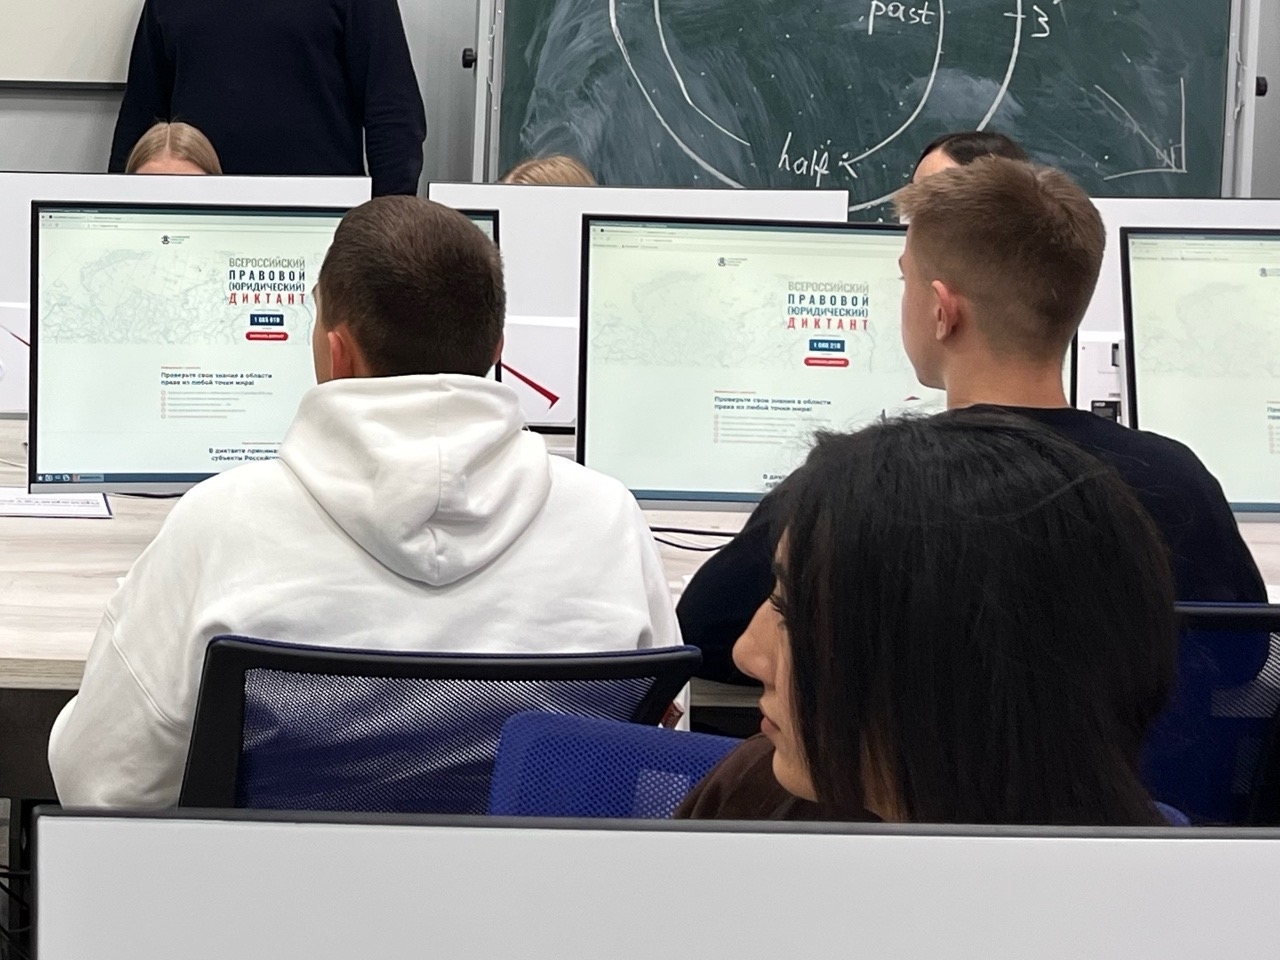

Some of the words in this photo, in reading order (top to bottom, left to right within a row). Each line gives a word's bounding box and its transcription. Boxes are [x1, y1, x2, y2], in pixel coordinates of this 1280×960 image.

[867, 0, 935, 35] past
[1030, 4, 1050, 38] 3
[778, 131, 830, 188] half
[228, 256, 306, 268] ВСЕРОССИЙСКИЙ
[228, 268, 306, 282] ПРАВОВОЙ
[228, 281, 306, 292] (ЮРИДИЧЕСКИЙ)
[787, 280, 870, 294] ВСЕРОССИЙСКИЙ
[228, 292, 306, 306] ДИКТАНТ
[787, 293, 870, 307] ПРАВОВОЙ
[787, 306, 869, 318] (ЮРИДИЧЕСКИЙ)
[787, 317, 869, 331] ДИКТАНТ
